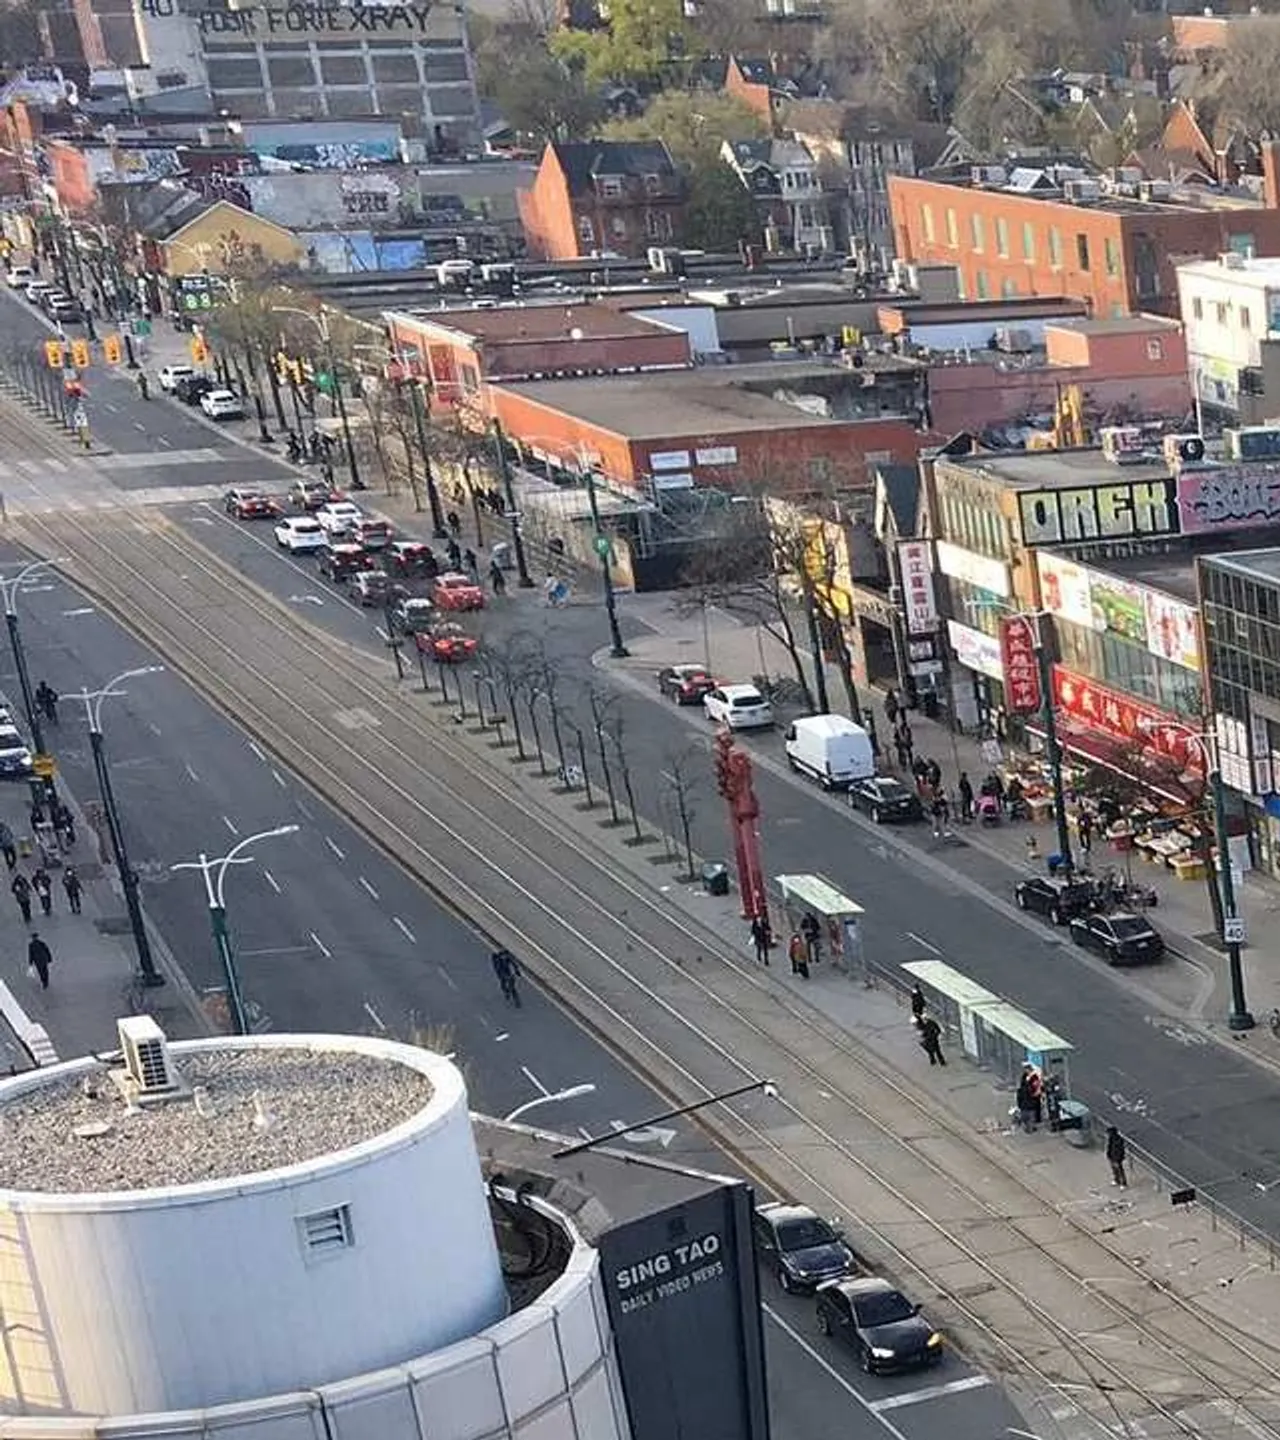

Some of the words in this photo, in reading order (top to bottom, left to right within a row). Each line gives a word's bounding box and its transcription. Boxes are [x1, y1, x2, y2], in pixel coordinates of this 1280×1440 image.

[616, 1255, 671, 1290] SING
[674, 1235, 720, 1265] TAO
[621, 1288, 655, 1314] DAILY
